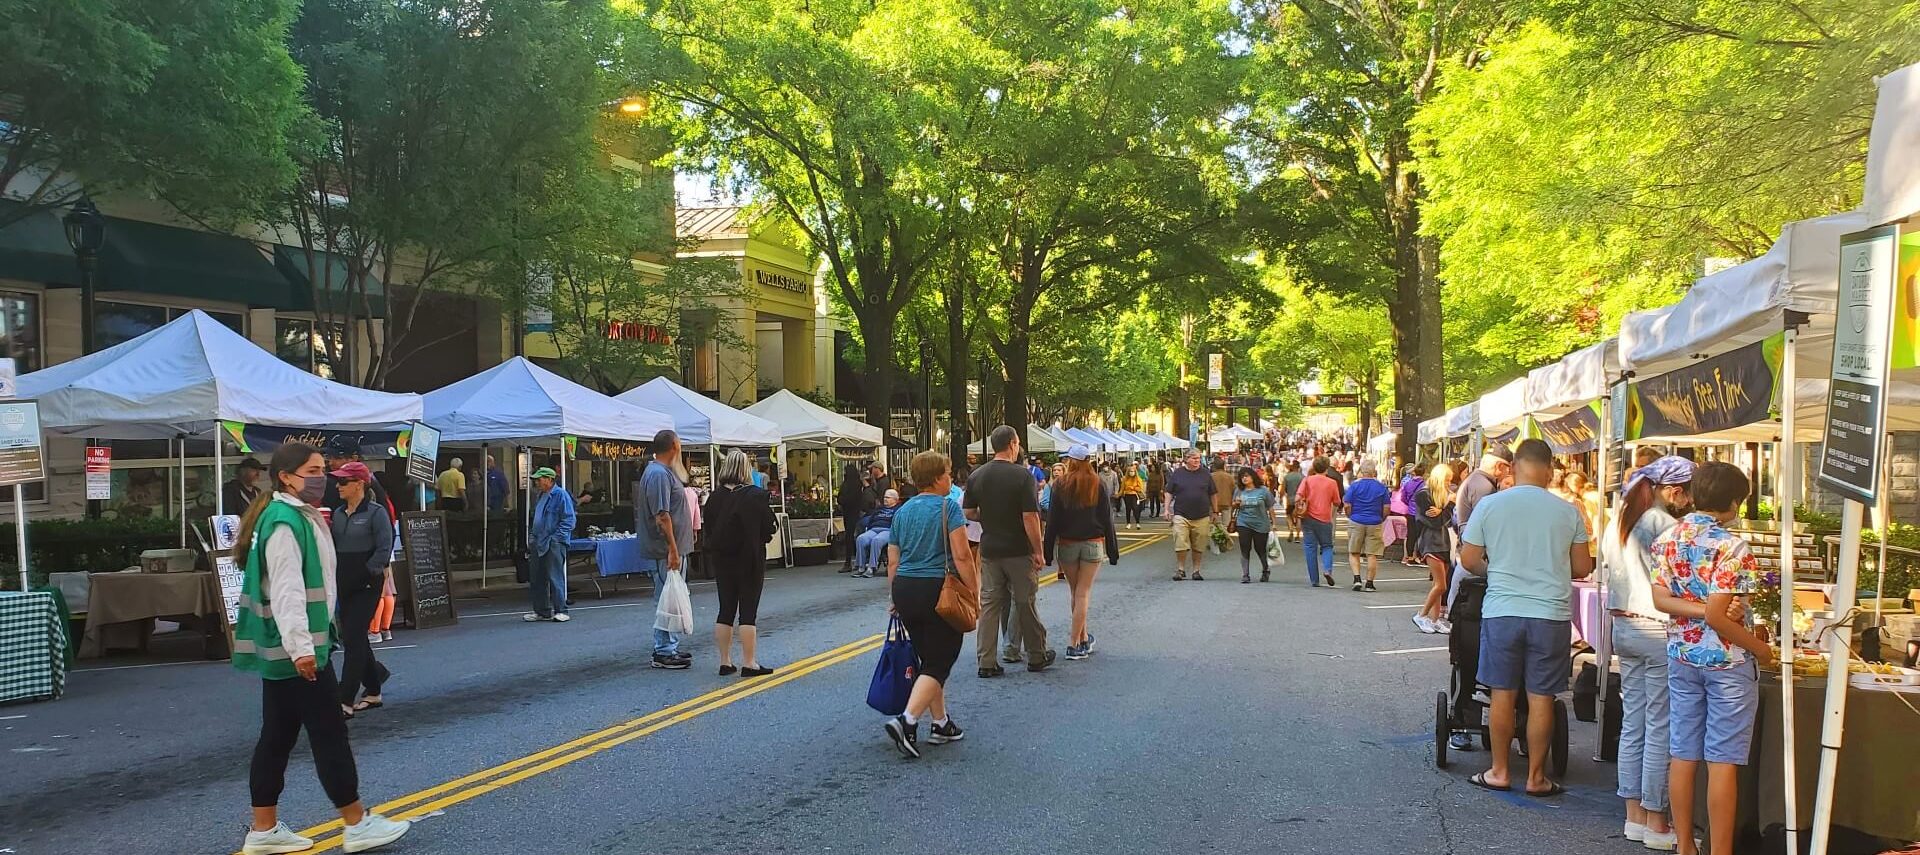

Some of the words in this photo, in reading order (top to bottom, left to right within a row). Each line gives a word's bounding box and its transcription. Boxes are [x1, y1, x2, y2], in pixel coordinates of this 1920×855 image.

[757, 270, 785, 288] WELLS
[786, 277, 806, 293] FARGO
[1841, 354, 1854, 368] SHOP
[1692, 378, 1717, 414] Bee
[1714, 367, 1752, 413] Farm
[592, 440, 602, 456] Blue
[606, 442, 620, 460] Ridge
[622, 442, 646, 458] Creamery
